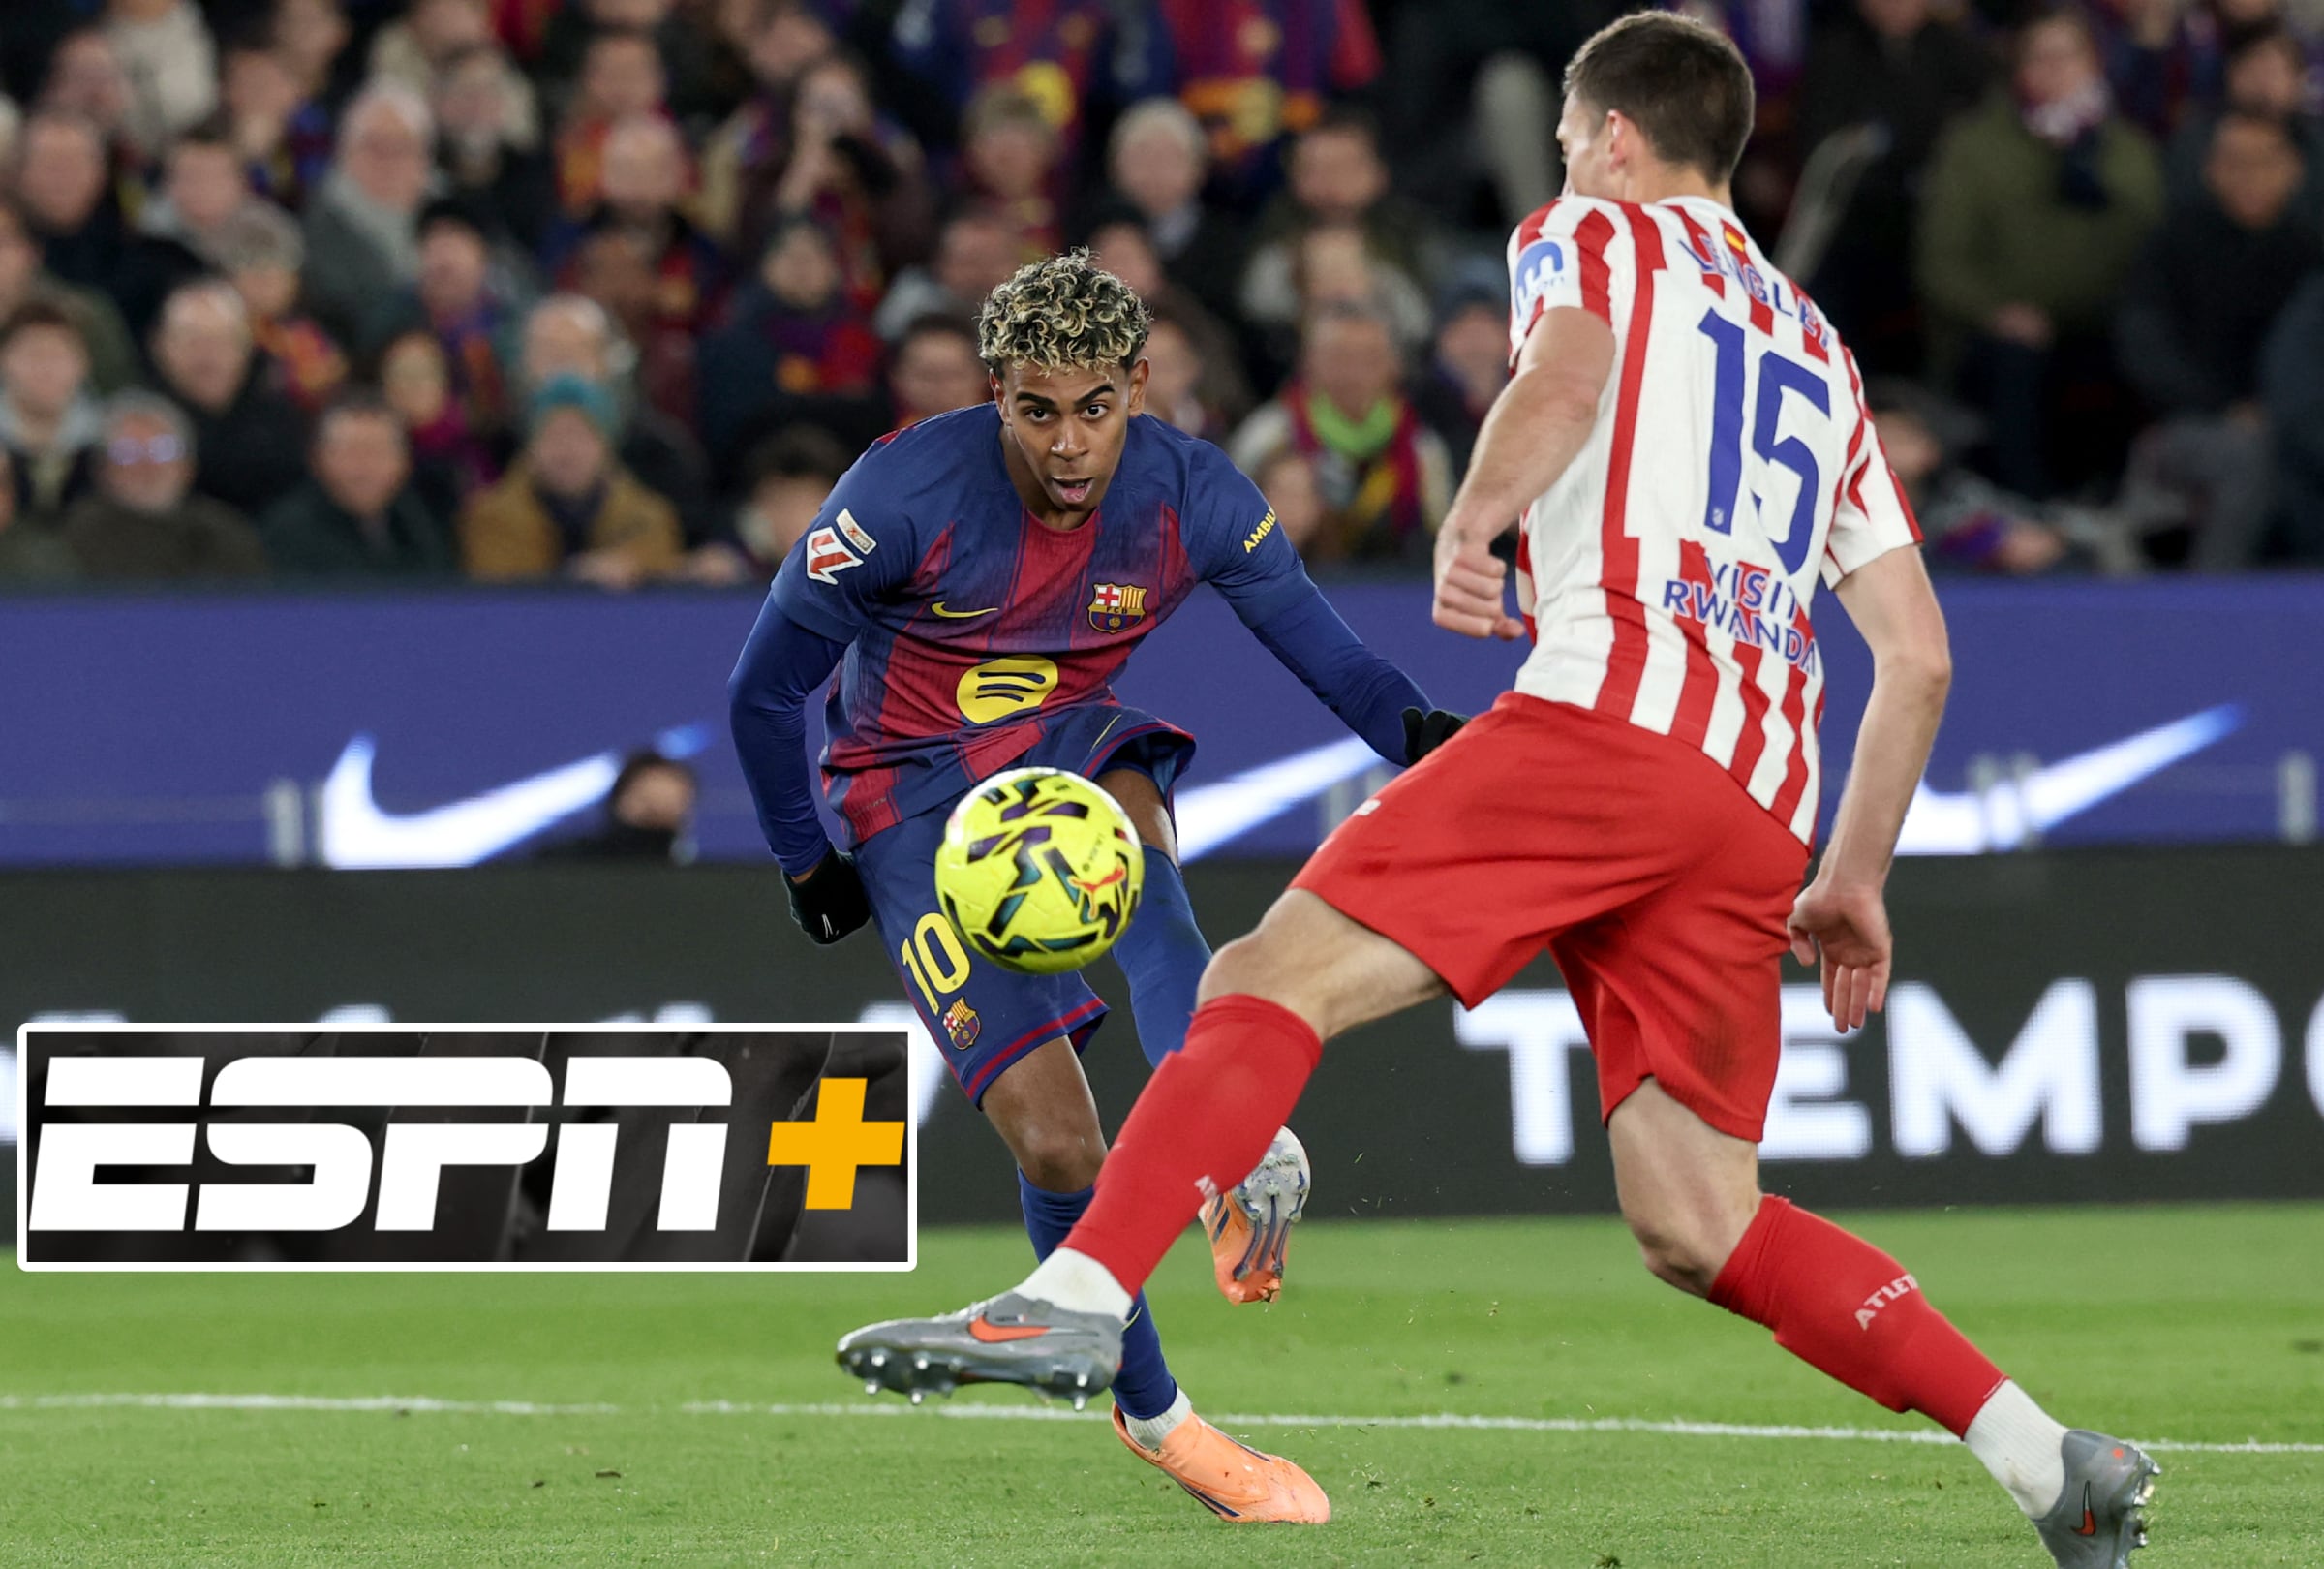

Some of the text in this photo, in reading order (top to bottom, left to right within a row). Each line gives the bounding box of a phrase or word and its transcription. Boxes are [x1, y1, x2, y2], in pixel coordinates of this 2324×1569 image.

[1697, 306, 1831, 576] 15
[1663, 579, 1817, 678] RWANDA
[901, 912, 971, 1017] 10
